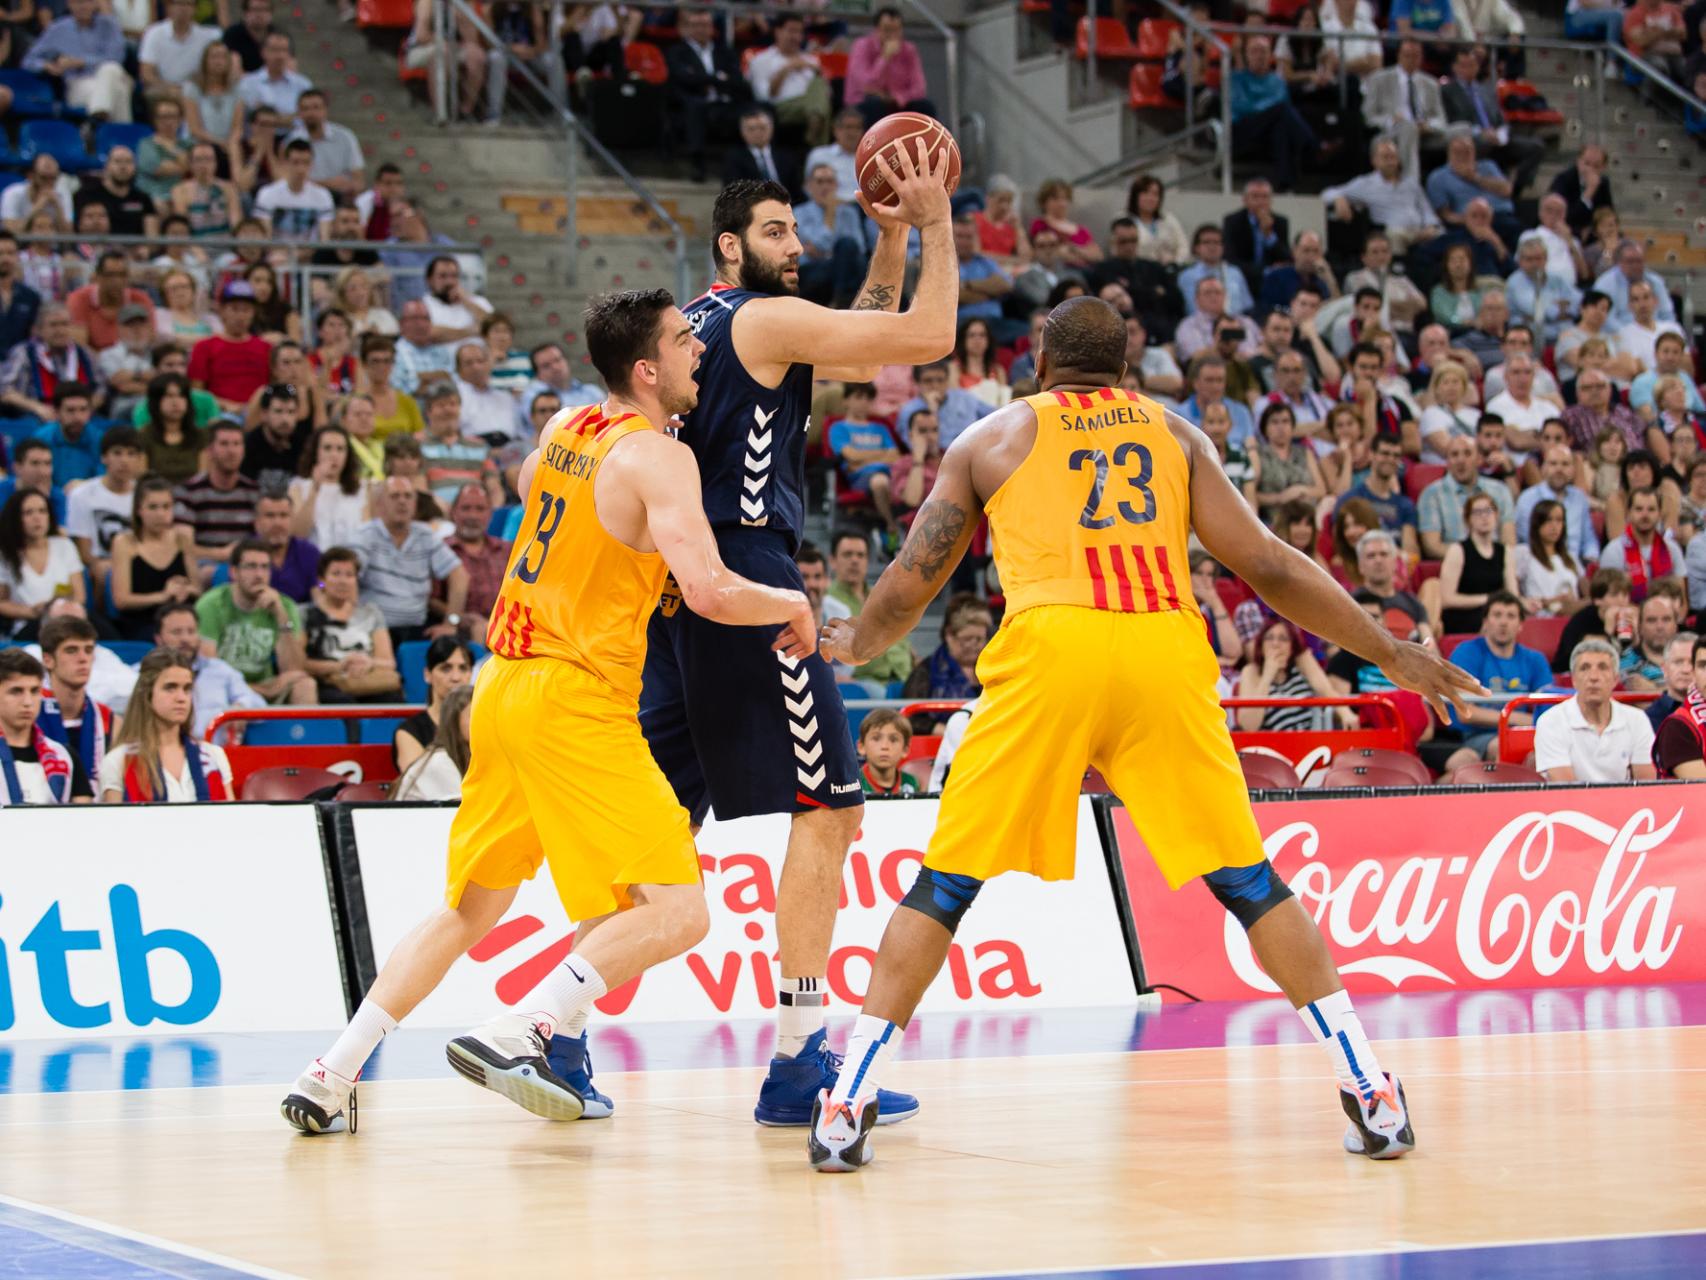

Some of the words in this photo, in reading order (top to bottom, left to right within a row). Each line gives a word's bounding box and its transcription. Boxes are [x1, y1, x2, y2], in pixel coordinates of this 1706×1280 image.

[1060, 407, 1150, 432] SAMUELS
[1068, 442, 1157, 530] 23
[509, 490, 566, 584] 13
[1224, 806, 1684, 993] Coca-Cola
